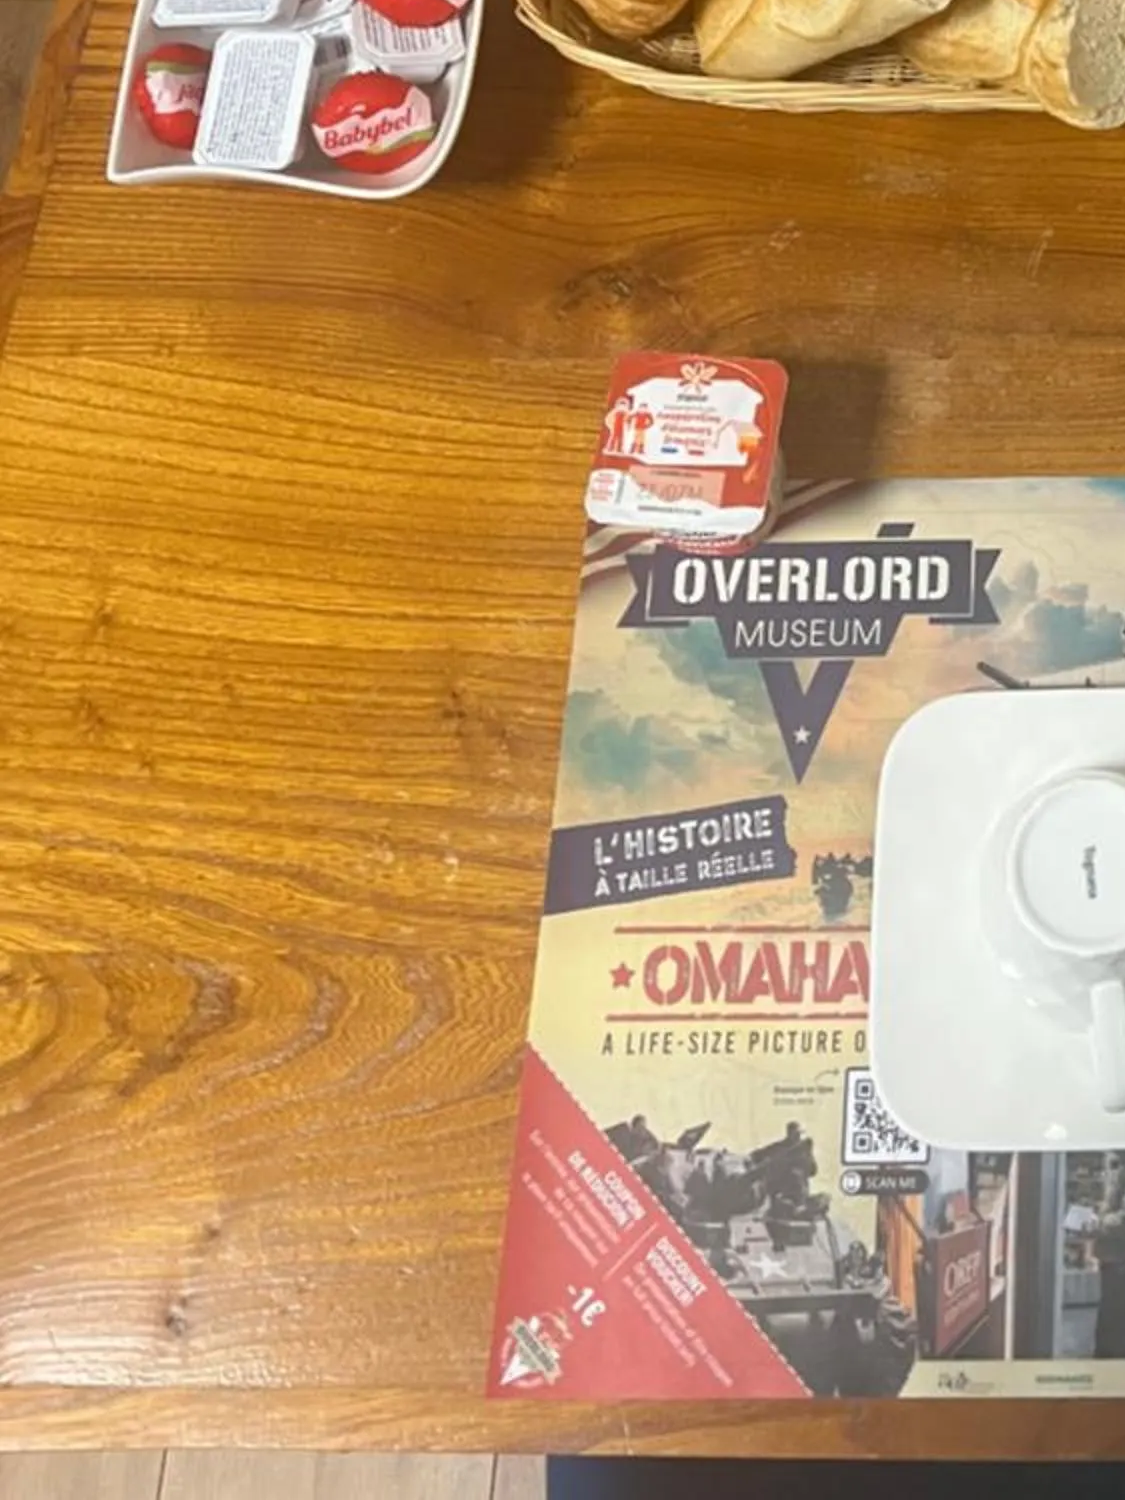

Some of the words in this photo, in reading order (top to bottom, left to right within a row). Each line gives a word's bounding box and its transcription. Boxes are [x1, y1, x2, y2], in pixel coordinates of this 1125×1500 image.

[324, 107, 412, 149] Babybel
[672, 555, 950, 604] OVERLORD
[735, 617, 881, 649] MUSEUM
[593, 807, 773, 866] L'HISTOIRE
[594, 868, 611, 897] À
[615, 862, 689, 894] TAILLE
[697, 849, 775, 881] RÉELLE
[642, 940, 870, 1006] OMAHA
[602, 1032, 613, 1055] A
[626, 1031, 736, 1055] LIFE-SIZE
[748, 1030, 843, 1054] PICTURE
[865, 1177, 896, 1189] SCAN
